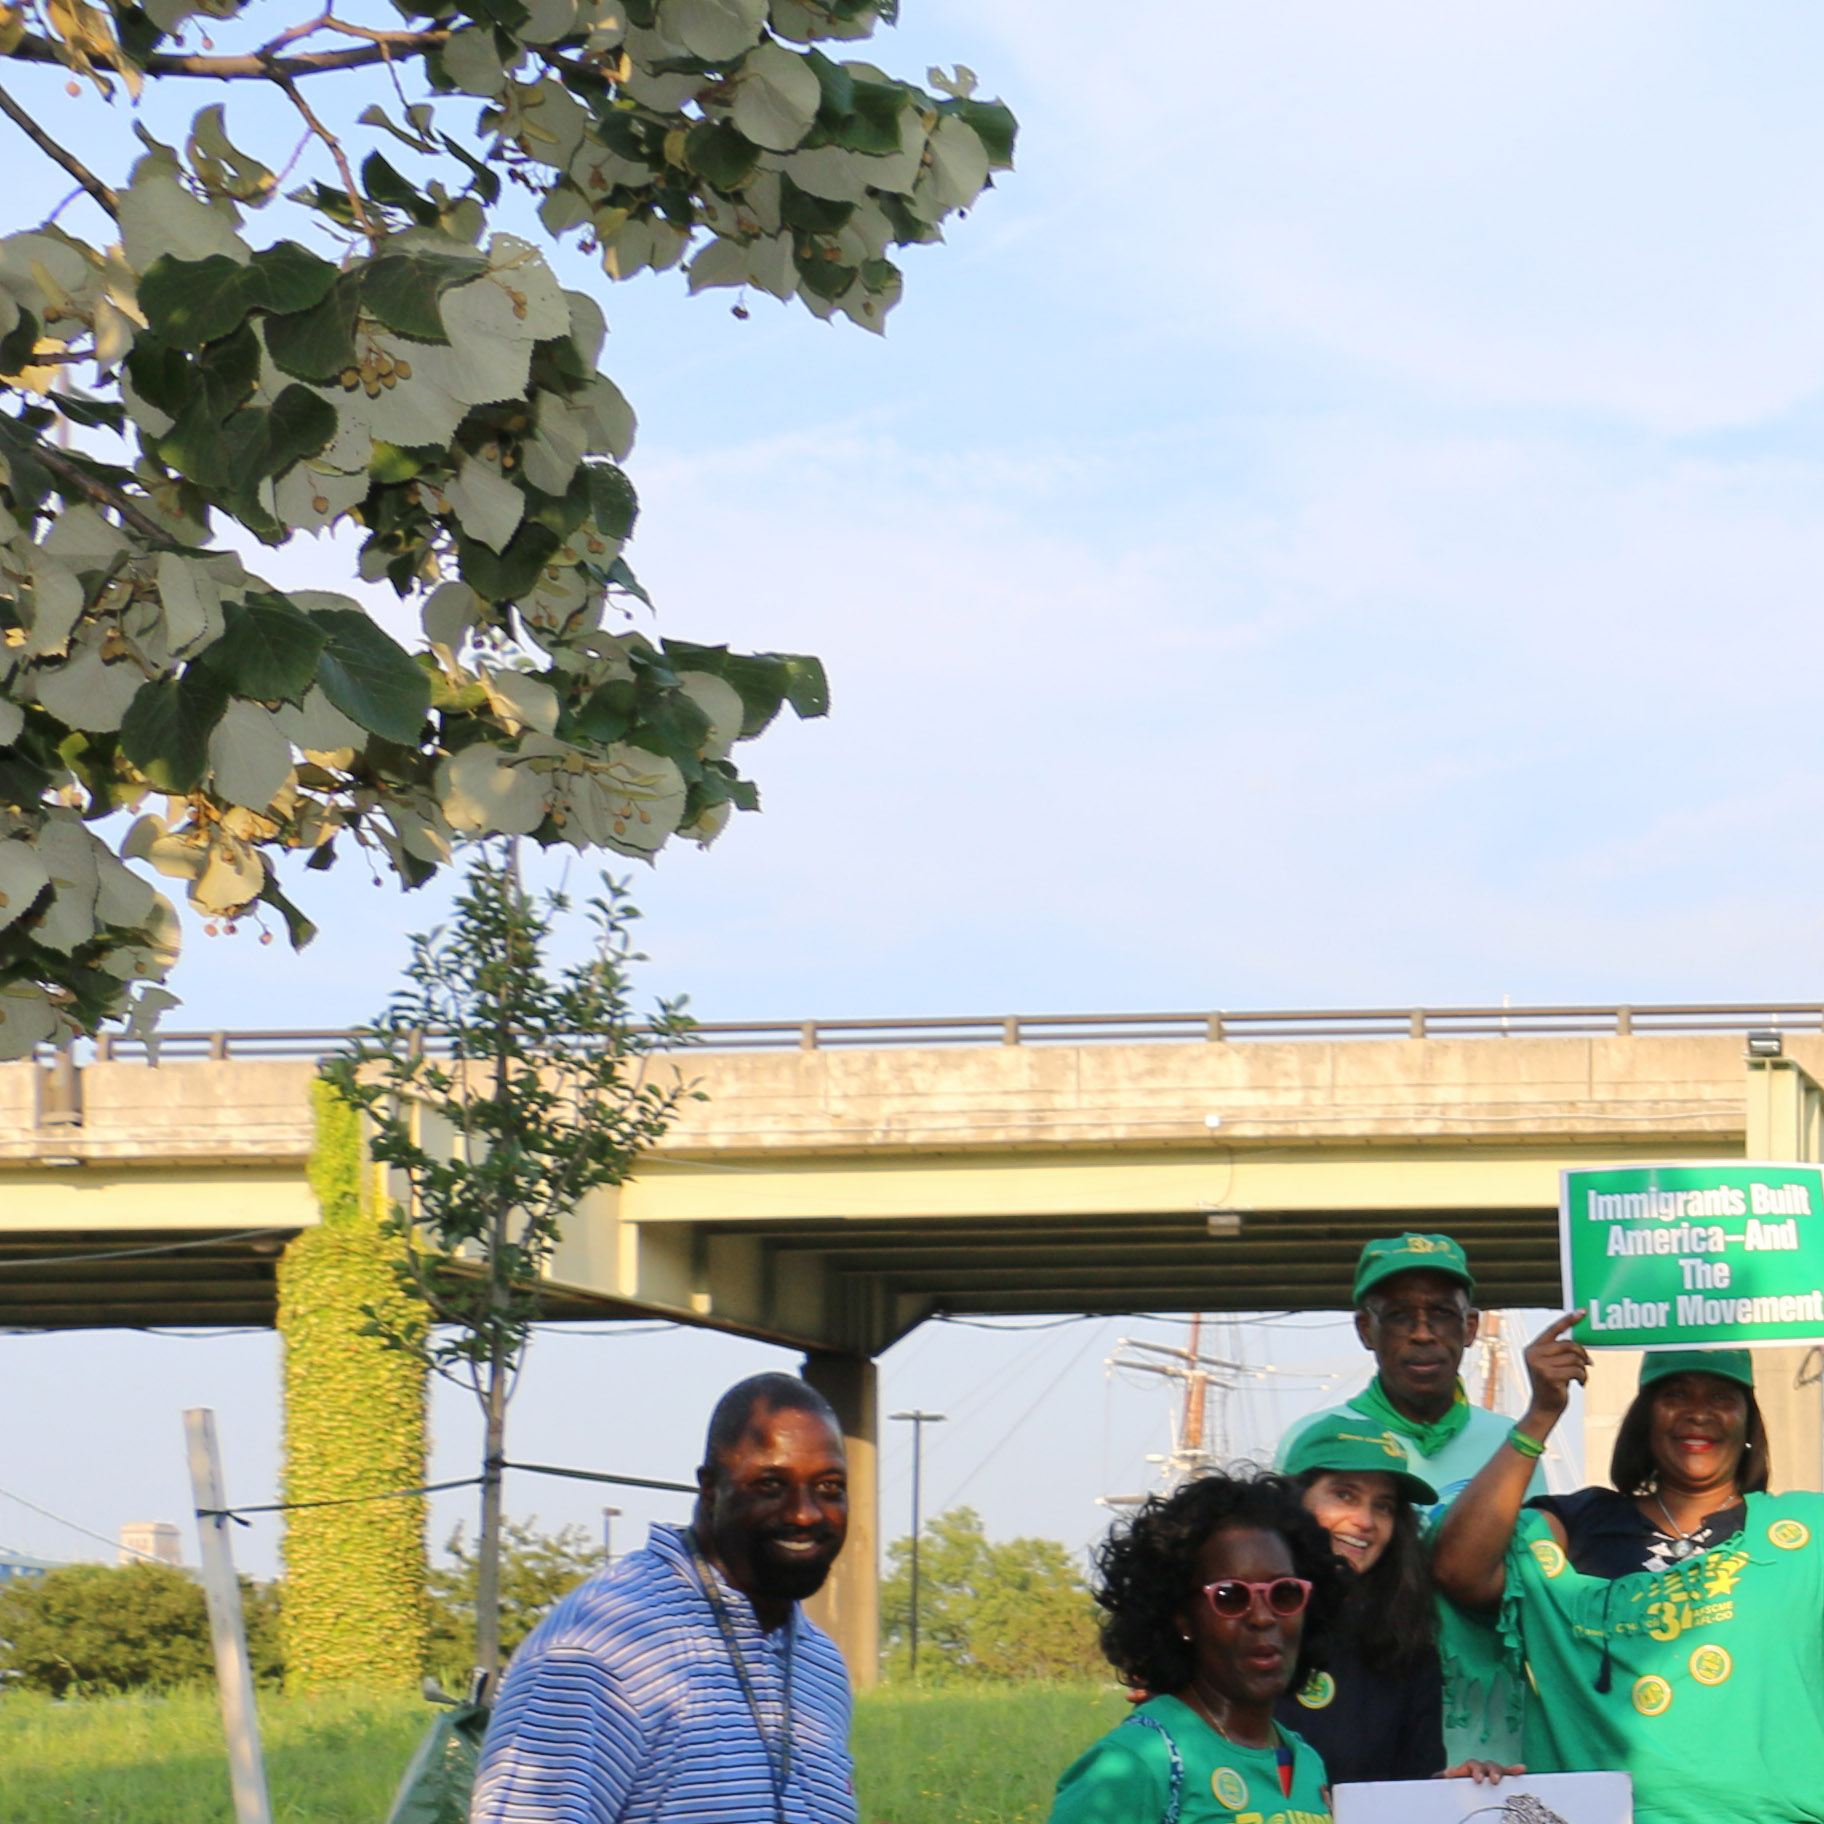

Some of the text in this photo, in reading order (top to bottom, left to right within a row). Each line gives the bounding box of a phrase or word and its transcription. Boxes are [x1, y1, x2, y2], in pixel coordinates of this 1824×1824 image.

[1587, 1182, 1812, 1222] Immigrants Built
[1678, 1258, 1731, 1290] The
[1589, 1290, 1824, 1330] Labor Movement
